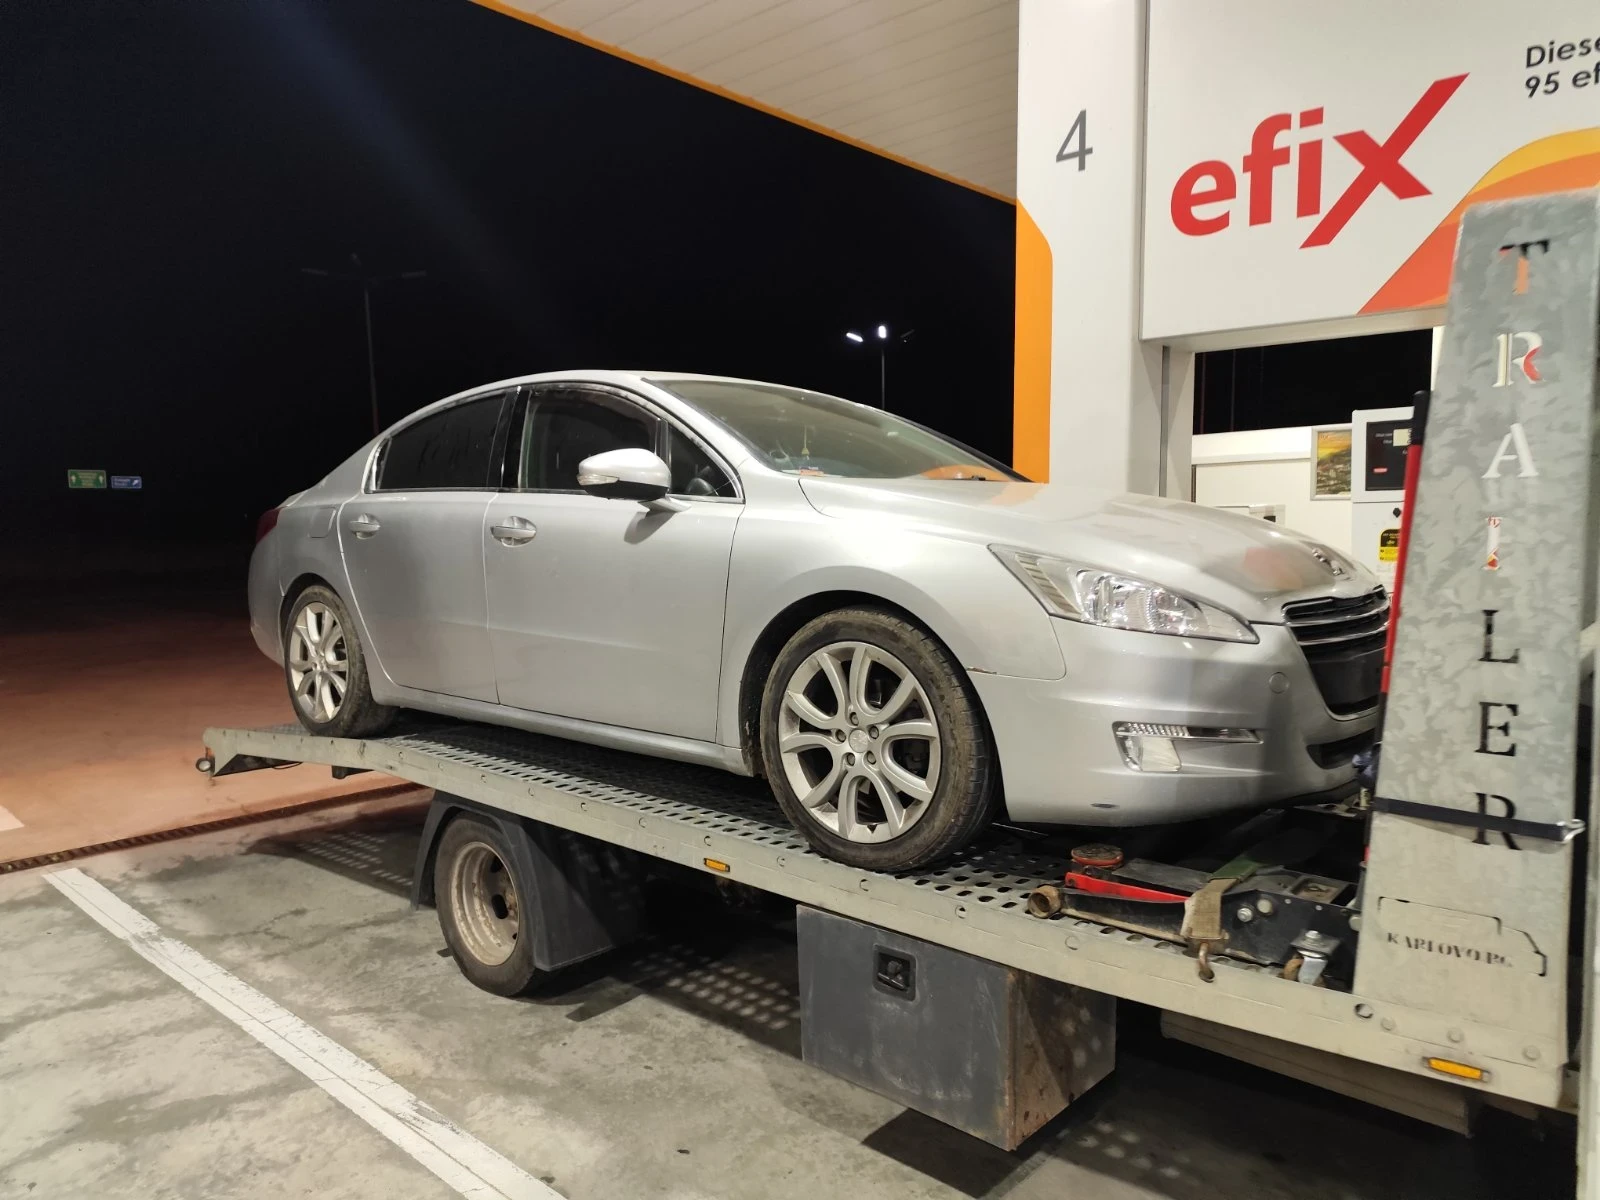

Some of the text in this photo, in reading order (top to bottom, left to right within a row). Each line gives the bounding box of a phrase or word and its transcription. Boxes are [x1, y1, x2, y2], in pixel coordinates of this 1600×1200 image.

[1526, 36, 1600, 69] Dies
[1525, 71, 1561, 99] 95
[1056, 109, 1094, 171] 4
[1170, 72, 1471, 249] efix
[1472, 239, 1551, 851] TRAILER
